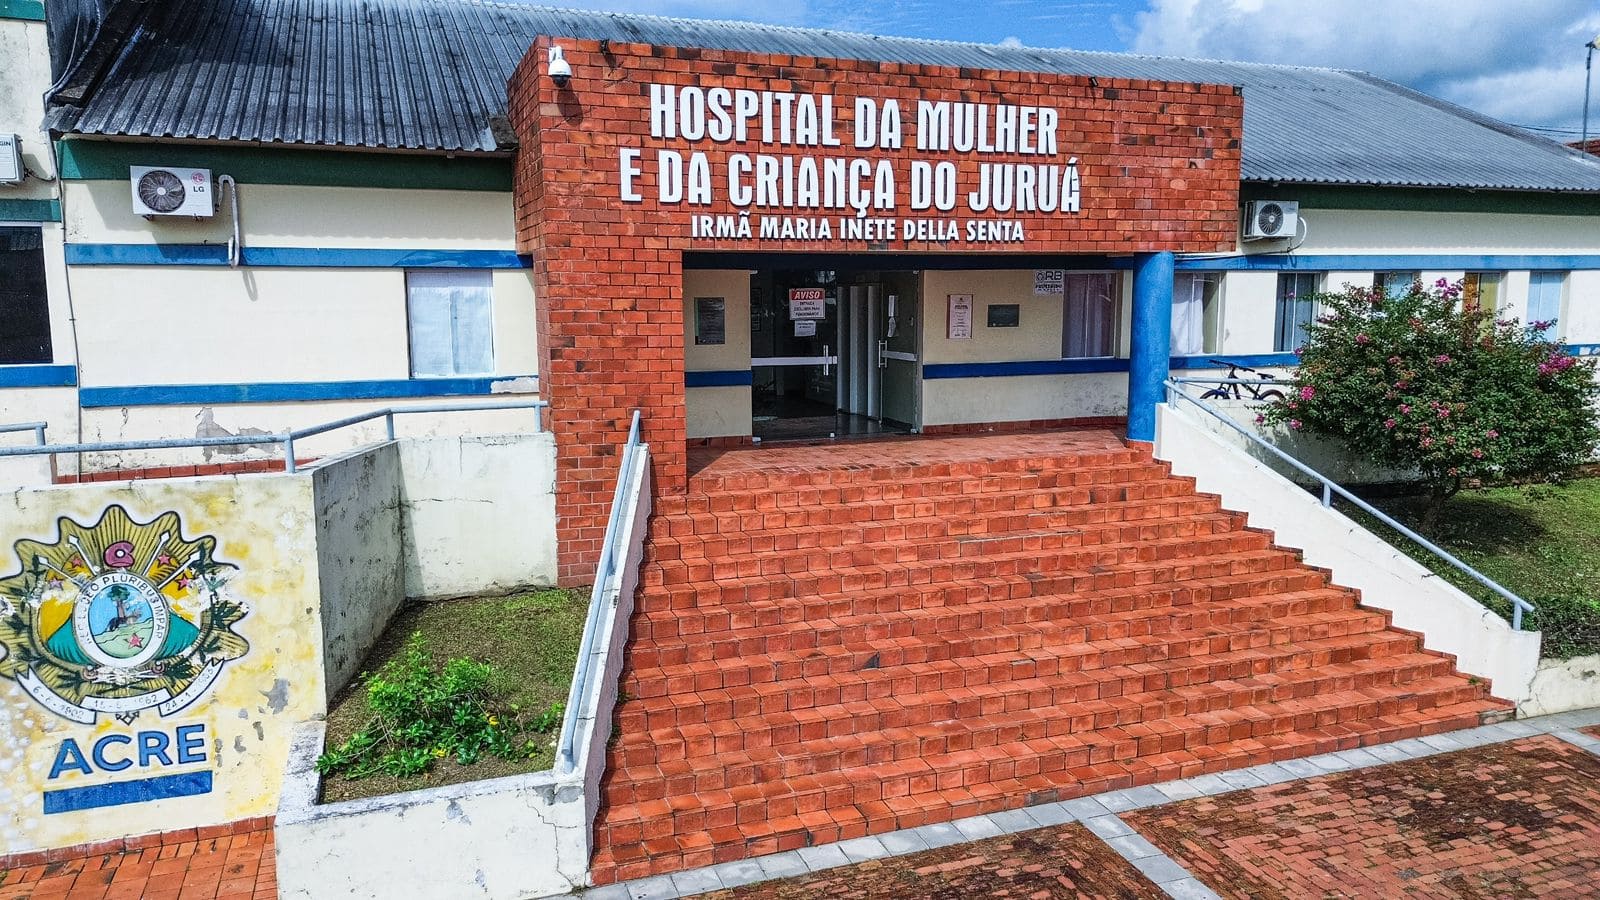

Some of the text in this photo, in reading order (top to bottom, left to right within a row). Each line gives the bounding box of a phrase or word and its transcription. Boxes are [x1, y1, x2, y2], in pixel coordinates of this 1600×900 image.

[650, 84, 1058, 155] HOSPITAL DA MULHER
[619, 148, 1080, 218] E DA CRIANÇA DO JURUÁ
[691, 210, 1024, 242] IRMÃ MARIA INETE DELLA SENTA
[794, 291, 820, 300] AVISO
[47, 723, 207, 779] ACRE
